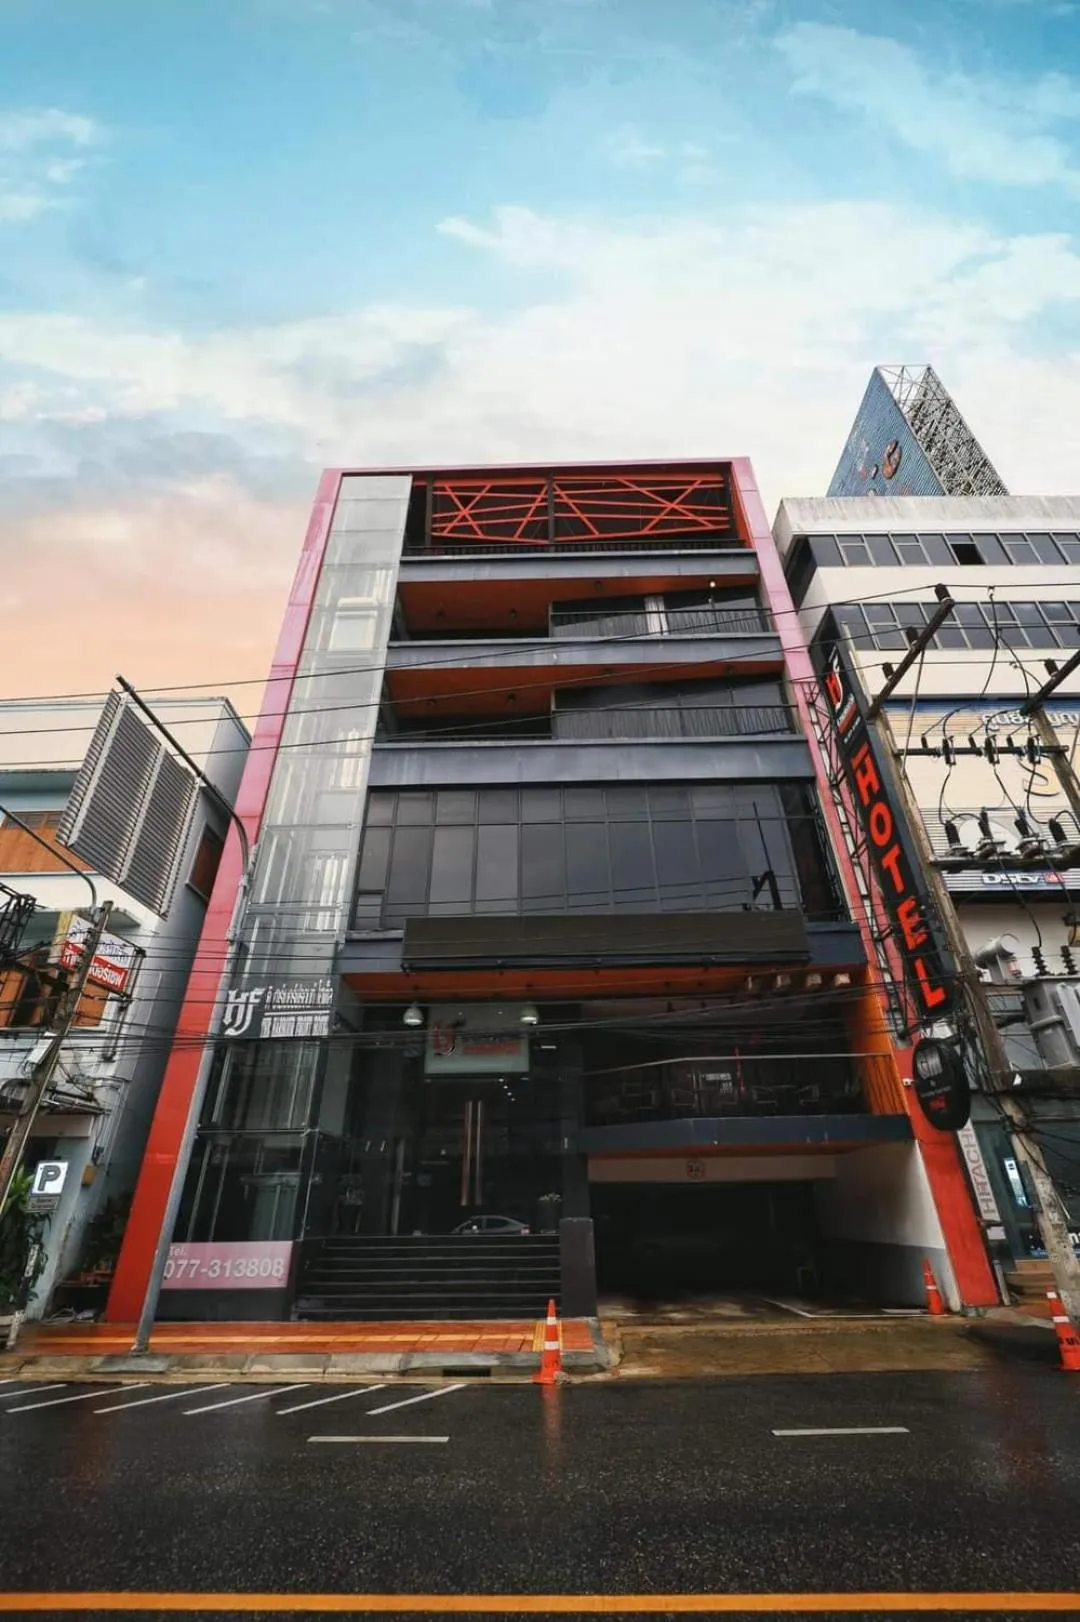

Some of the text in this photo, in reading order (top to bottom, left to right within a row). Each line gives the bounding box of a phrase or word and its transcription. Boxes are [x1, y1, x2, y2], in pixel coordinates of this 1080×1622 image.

[851, 742, 947, 1008] HOTEL
[37, 1164, 62, 1192] P
[961, 1127, 997, 1214] HITACHI
[168, 1245, 186, 1257] Tel.
[162, 1258, 285, 1279] 077-313808
